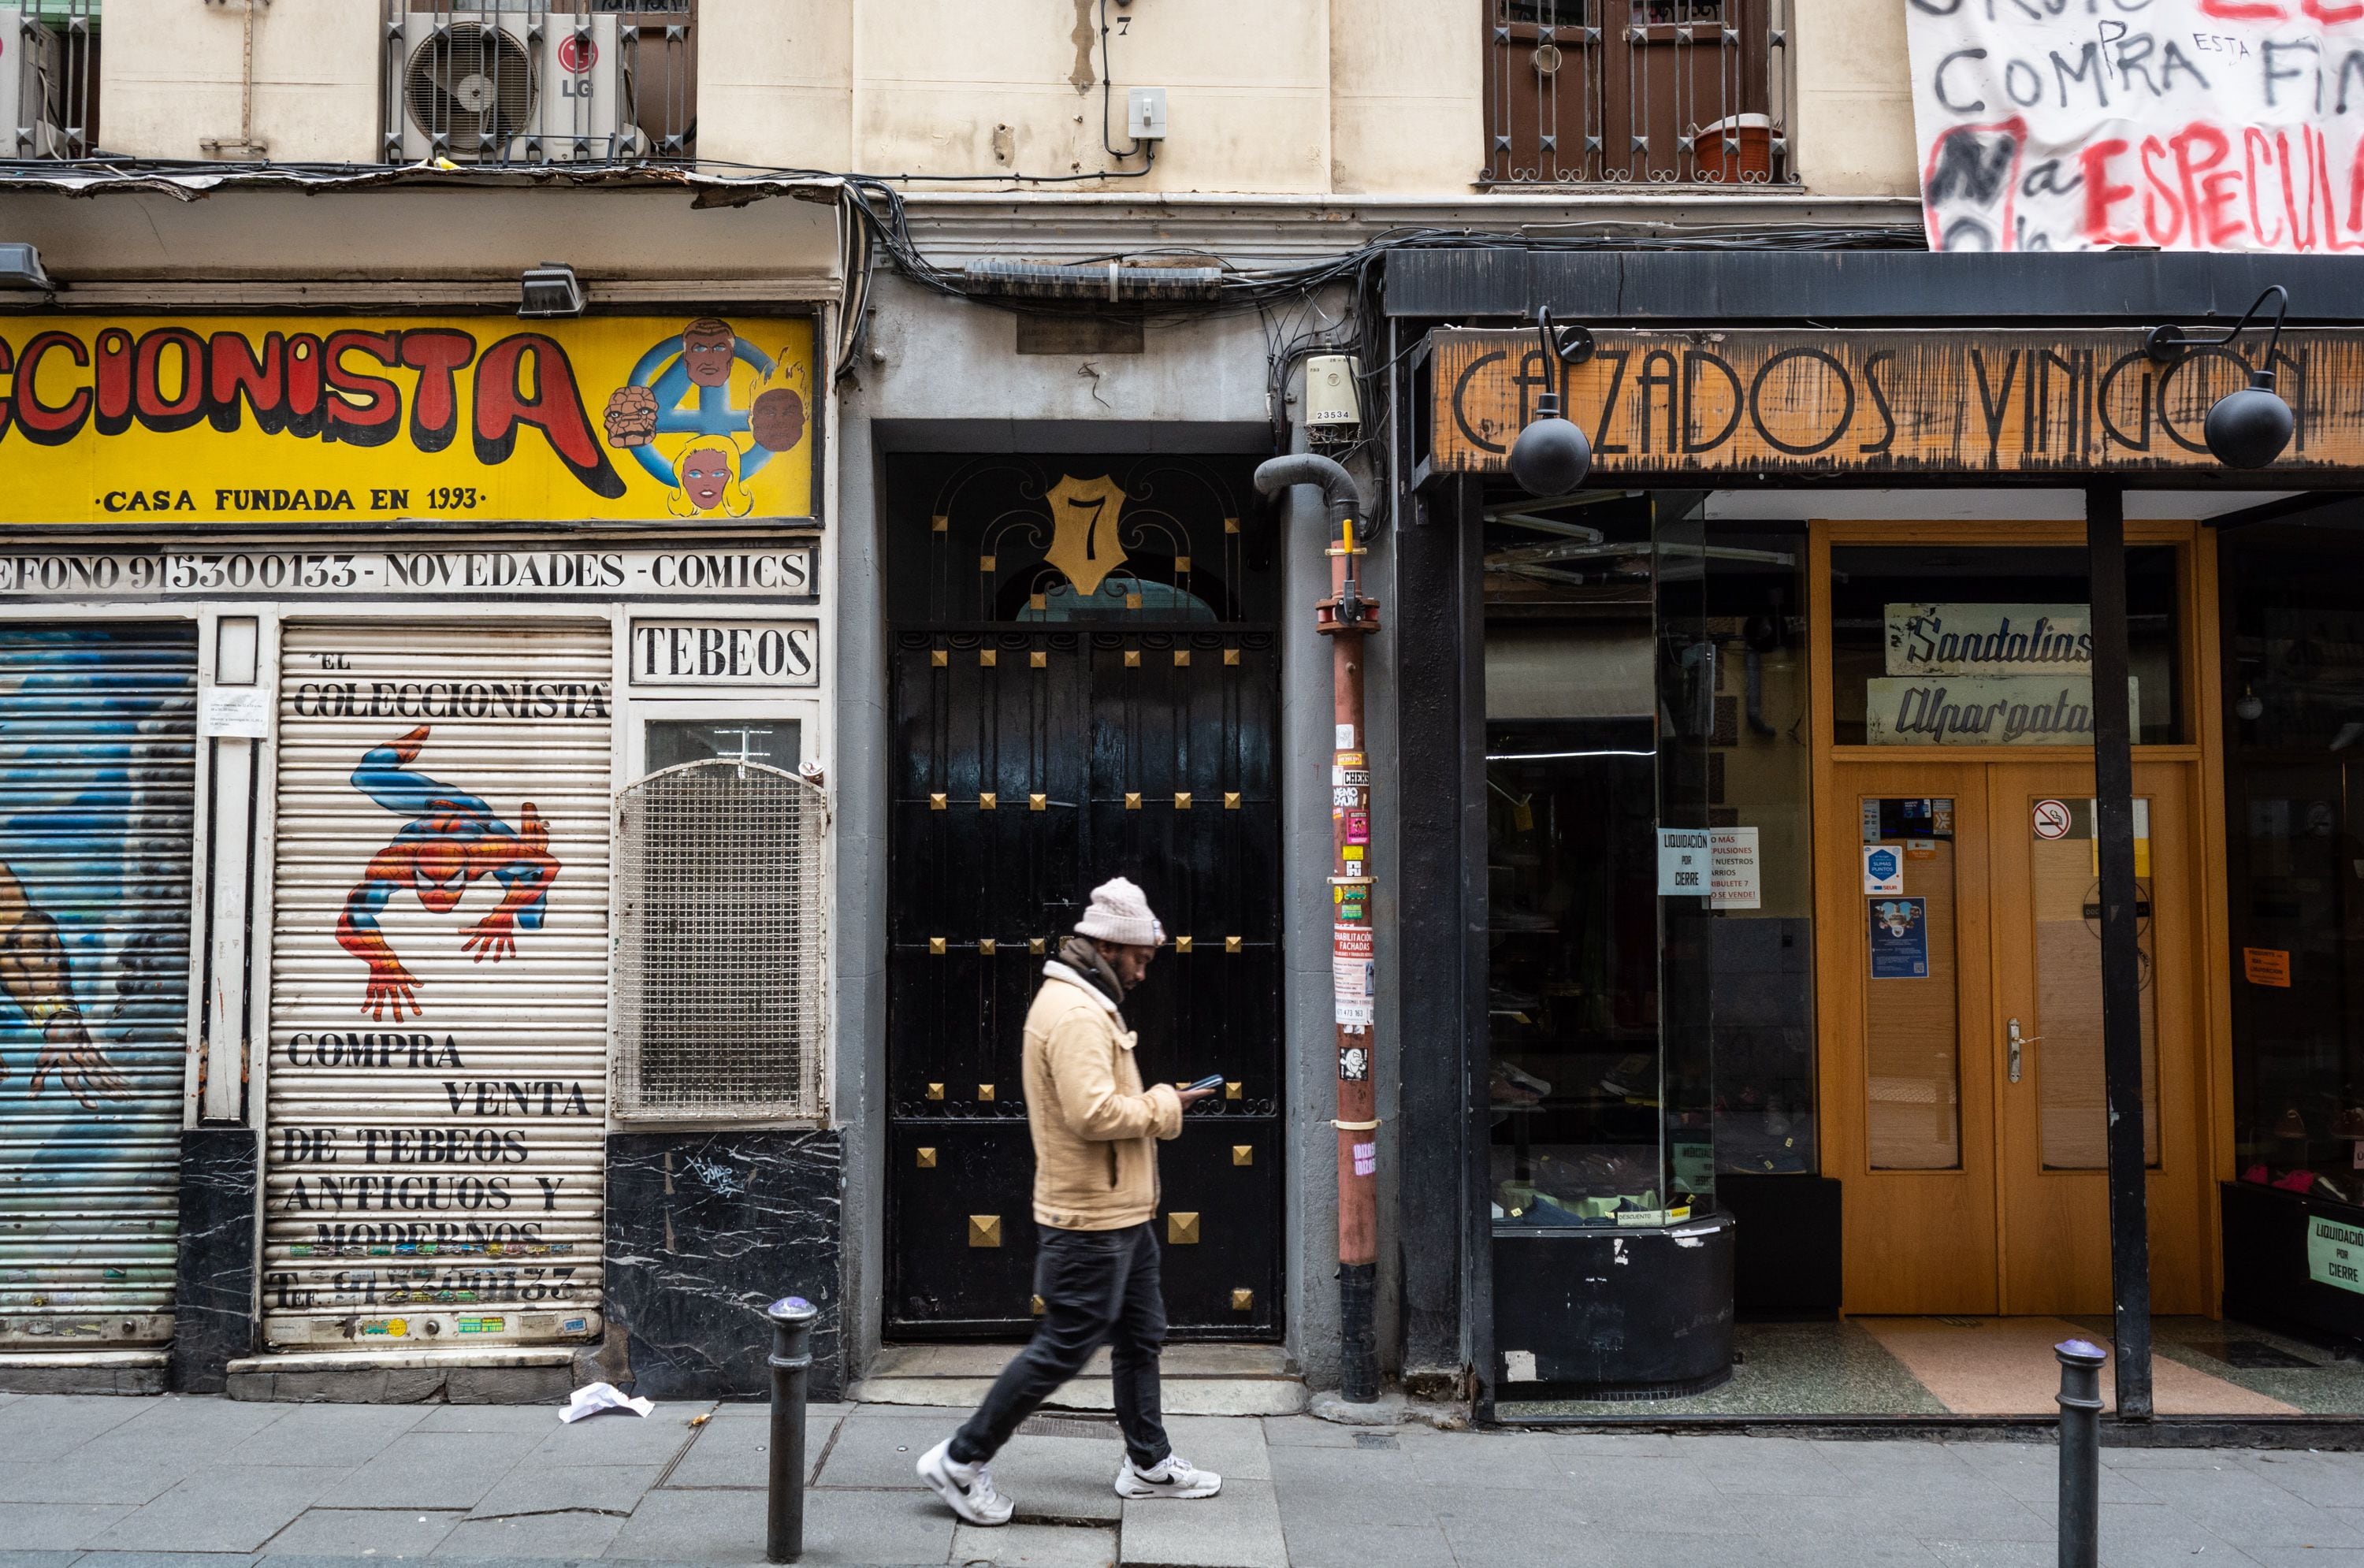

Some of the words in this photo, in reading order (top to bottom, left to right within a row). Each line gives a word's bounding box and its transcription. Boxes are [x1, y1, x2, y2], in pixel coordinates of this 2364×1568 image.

[1116, 16, 1132, 36] 7
[1935, 19, 2209, 113] COMPRA
[2193, 32, 2251, 60] ESTA
[562, 80, 593, 98] LG
[0, 325, 628, 500] CIONISTA
[215, 489, 356, 511] FUNDADA
[370, 489, 410, 511] EN
[1068, 495, 1106, 560] 7
[637, 628, 812, 677] TEBEOS
[1895, 686, 2095, 743] Alpargata
[1664, 832, 1708, 849] LIQUIDACIÓN
[1682, 856, 1692, 865] POR
[1675, 871, 1699, 886] CIERRE
[1340, 941, 1370, 951] FACHADAS
[287, 1033, 465, 1068] COMPRA
[442, 1081, 592, 1117] VENTA
[283, 1128, 337, 1163] DE
[357, 1128, 528, 1164] TEBEOS
[284, 1176, 512, 1211] ANTIGUOS
[535, 1177, 565, 1211] Y
[316, 1222, 545, 1247] MODERNOS
[2336, 1248, 2349, 1260] POR
[2329, 1262, 2358, 1283] CIERRE
